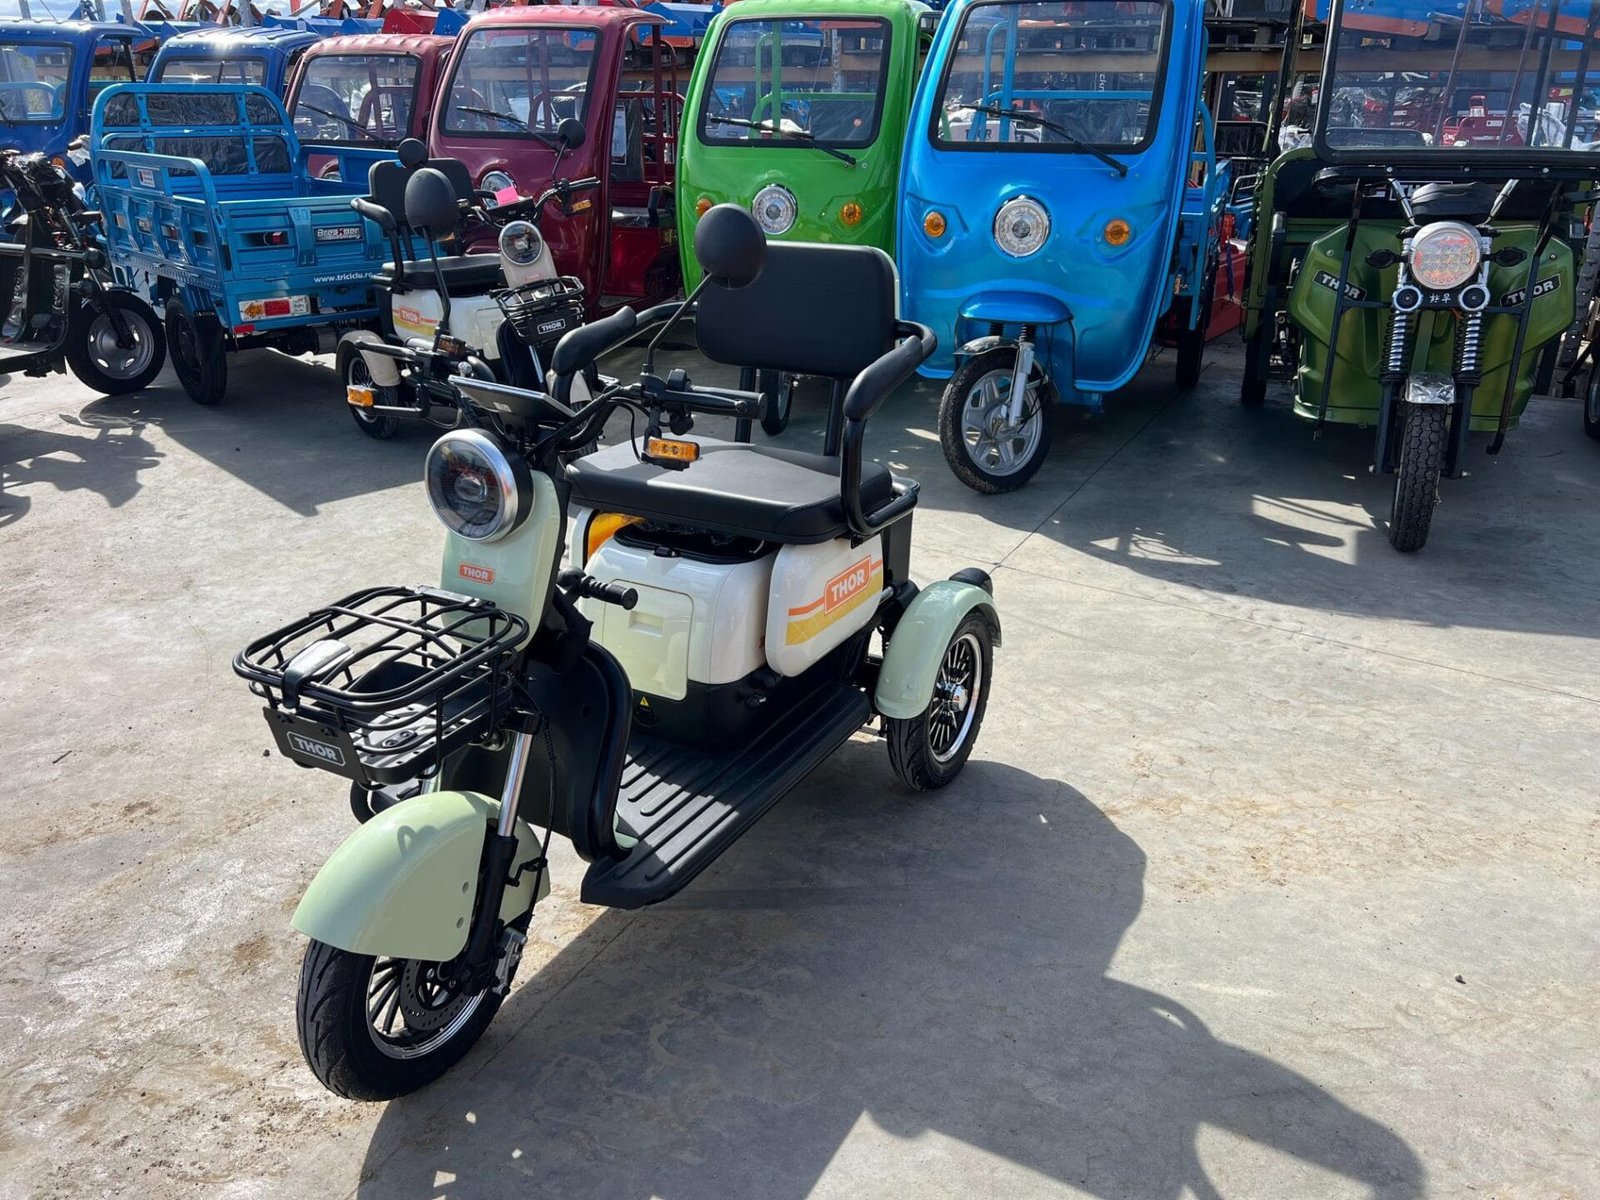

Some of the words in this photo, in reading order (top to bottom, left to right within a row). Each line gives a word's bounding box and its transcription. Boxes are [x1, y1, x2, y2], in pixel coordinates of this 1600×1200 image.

[541, 321, 562, 331] THOR
[463, 566, 489, 580] THOR
[831, 568, 865, 602] THOR
[294, 736, 338, 761] THOR
